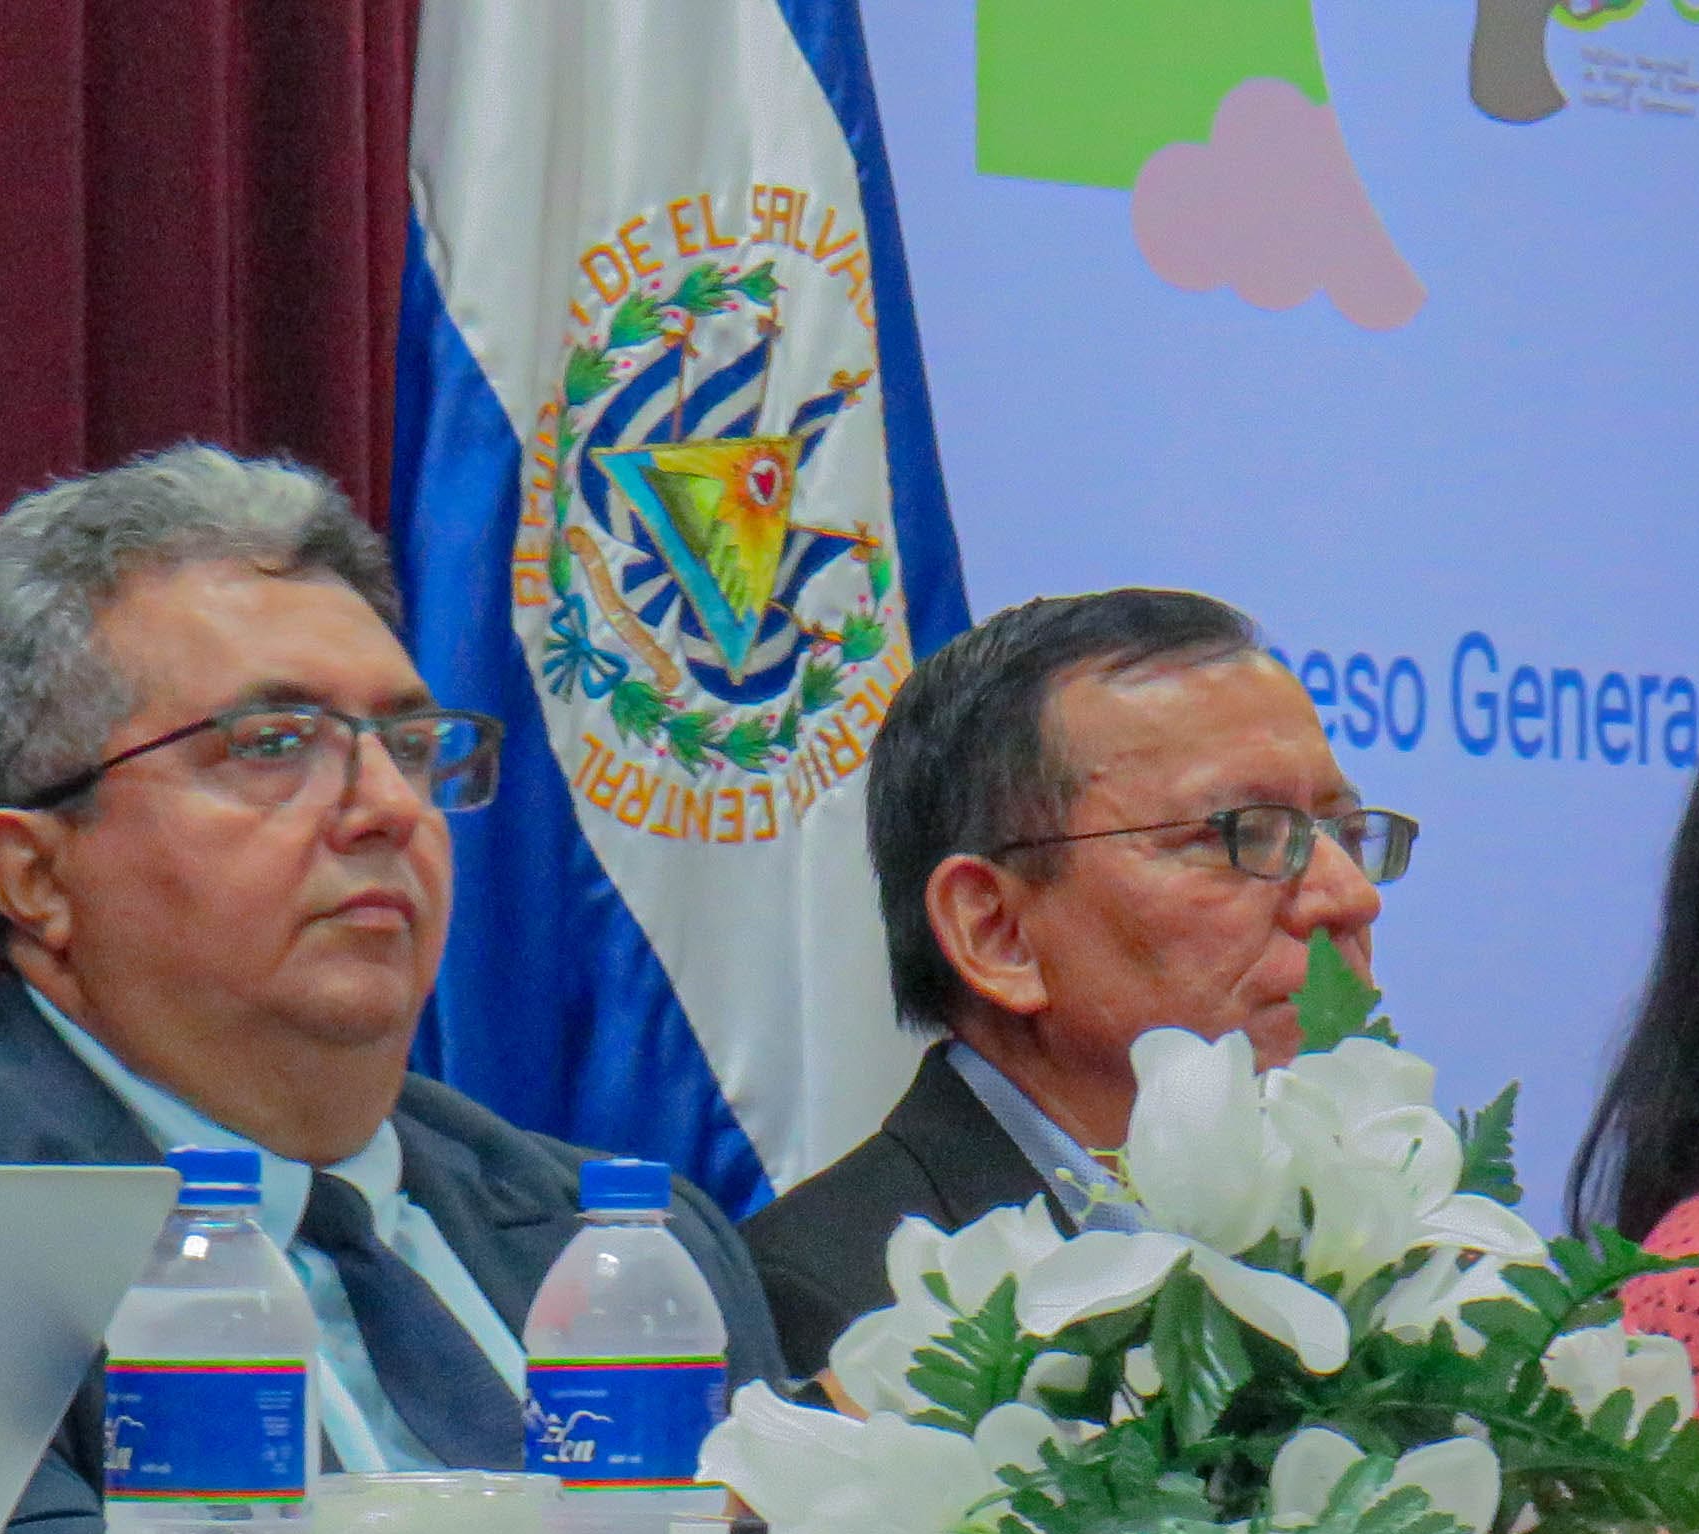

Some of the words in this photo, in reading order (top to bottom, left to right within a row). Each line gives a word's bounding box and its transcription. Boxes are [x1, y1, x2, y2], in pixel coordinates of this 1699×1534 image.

[579, 214, 664, 306] DE
[666, 193, 738, 258] EL
[1268, 645, 1427, 752] eso
[573, 732, 778, 843] CENTRAL
